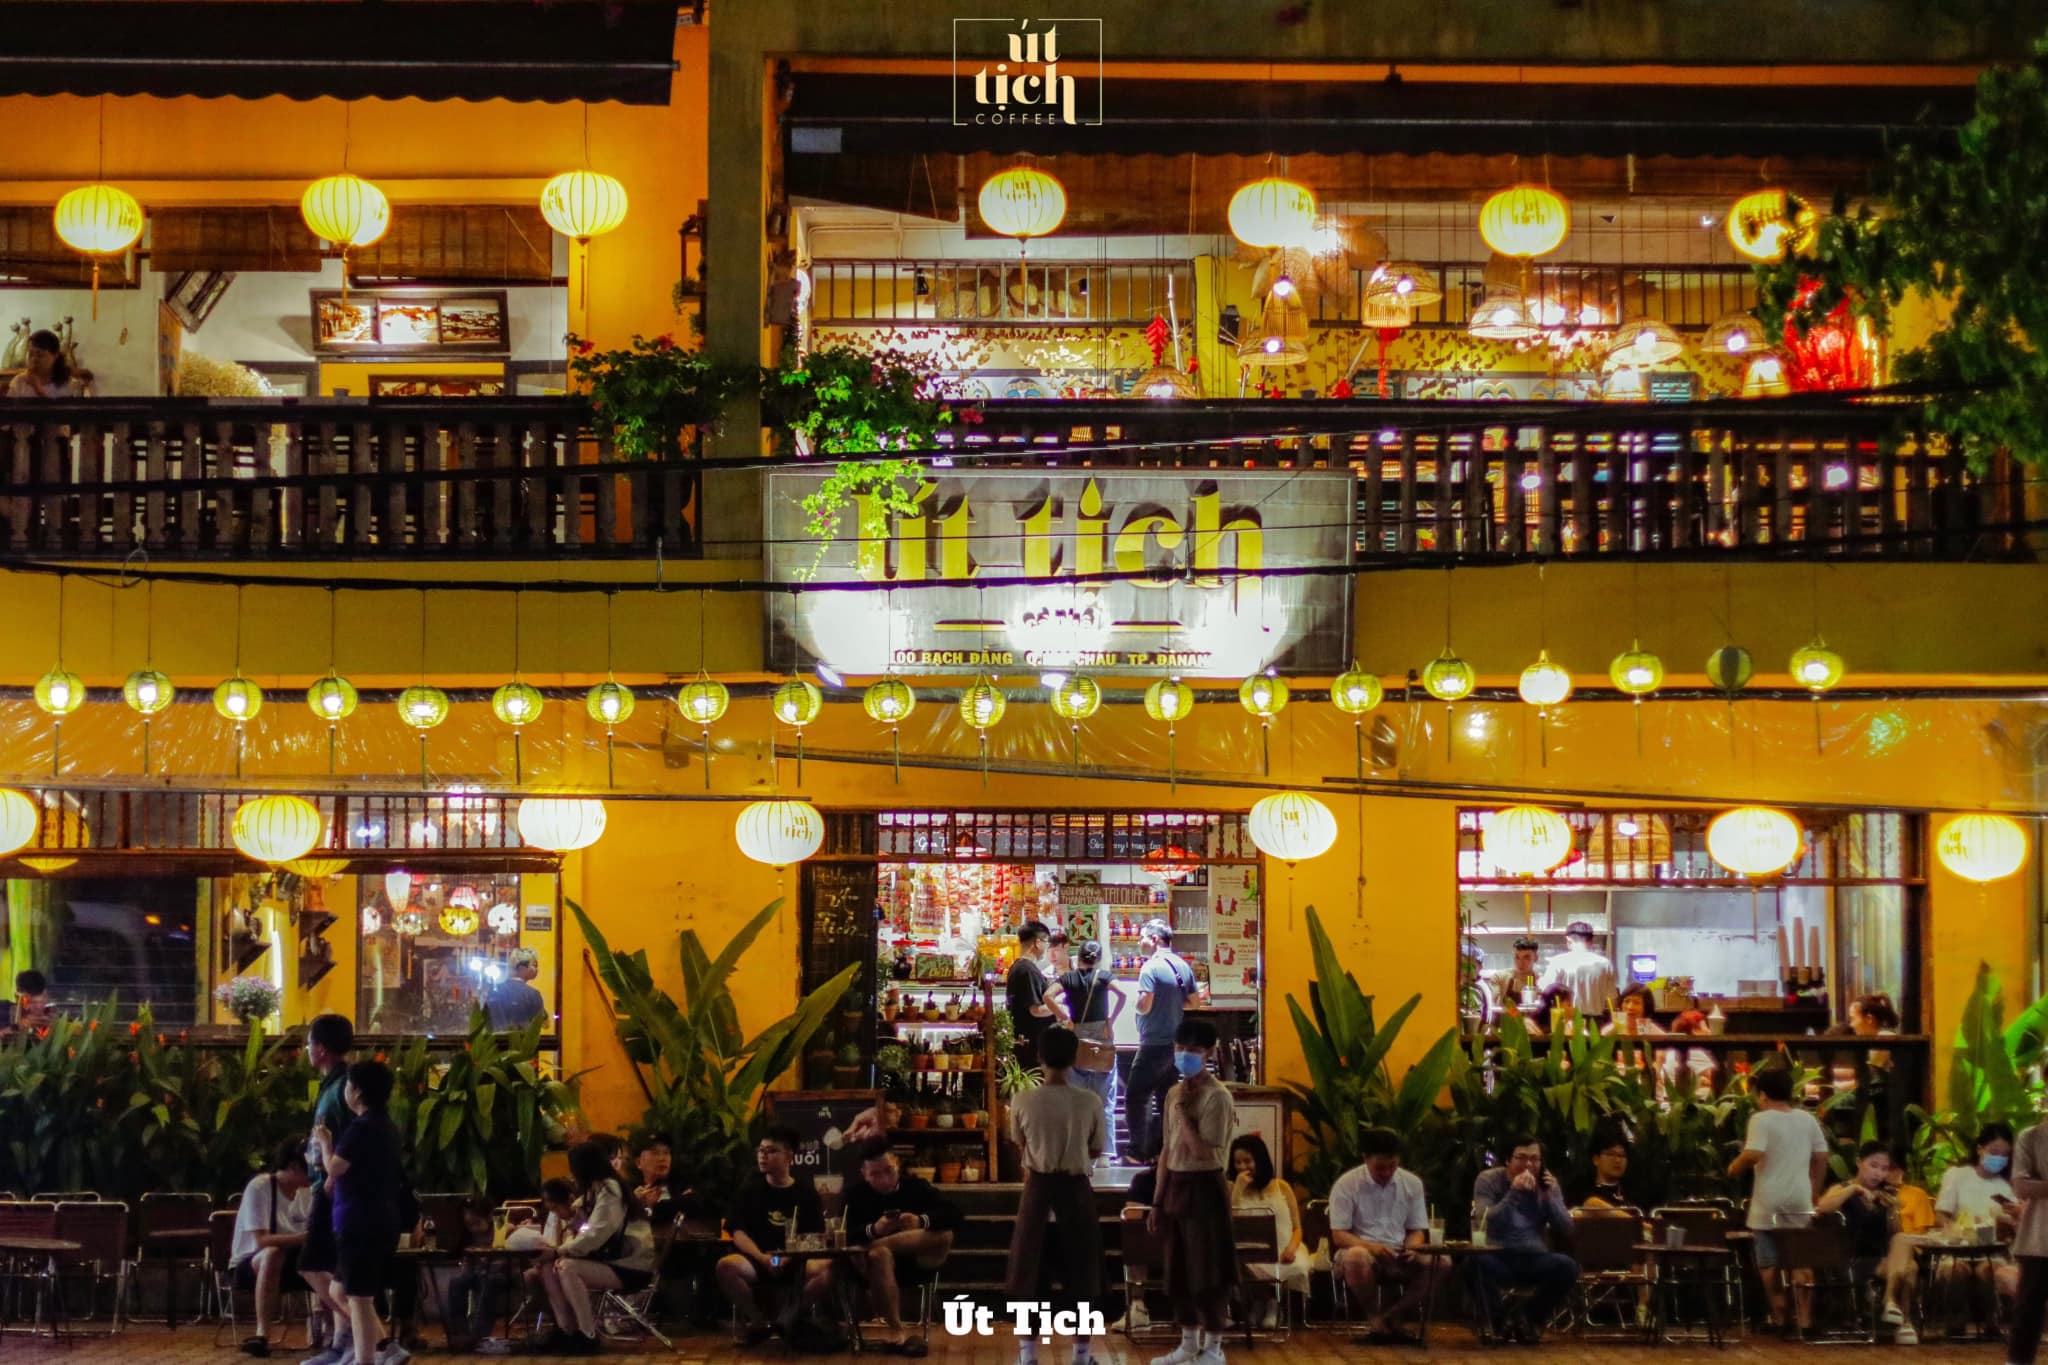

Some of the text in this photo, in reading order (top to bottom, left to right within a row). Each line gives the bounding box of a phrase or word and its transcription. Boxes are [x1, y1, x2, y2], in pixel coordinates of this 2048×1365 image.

[851, 477, 1264, 618] út tịch
[790, 1150, 820, 1165] UỐI
